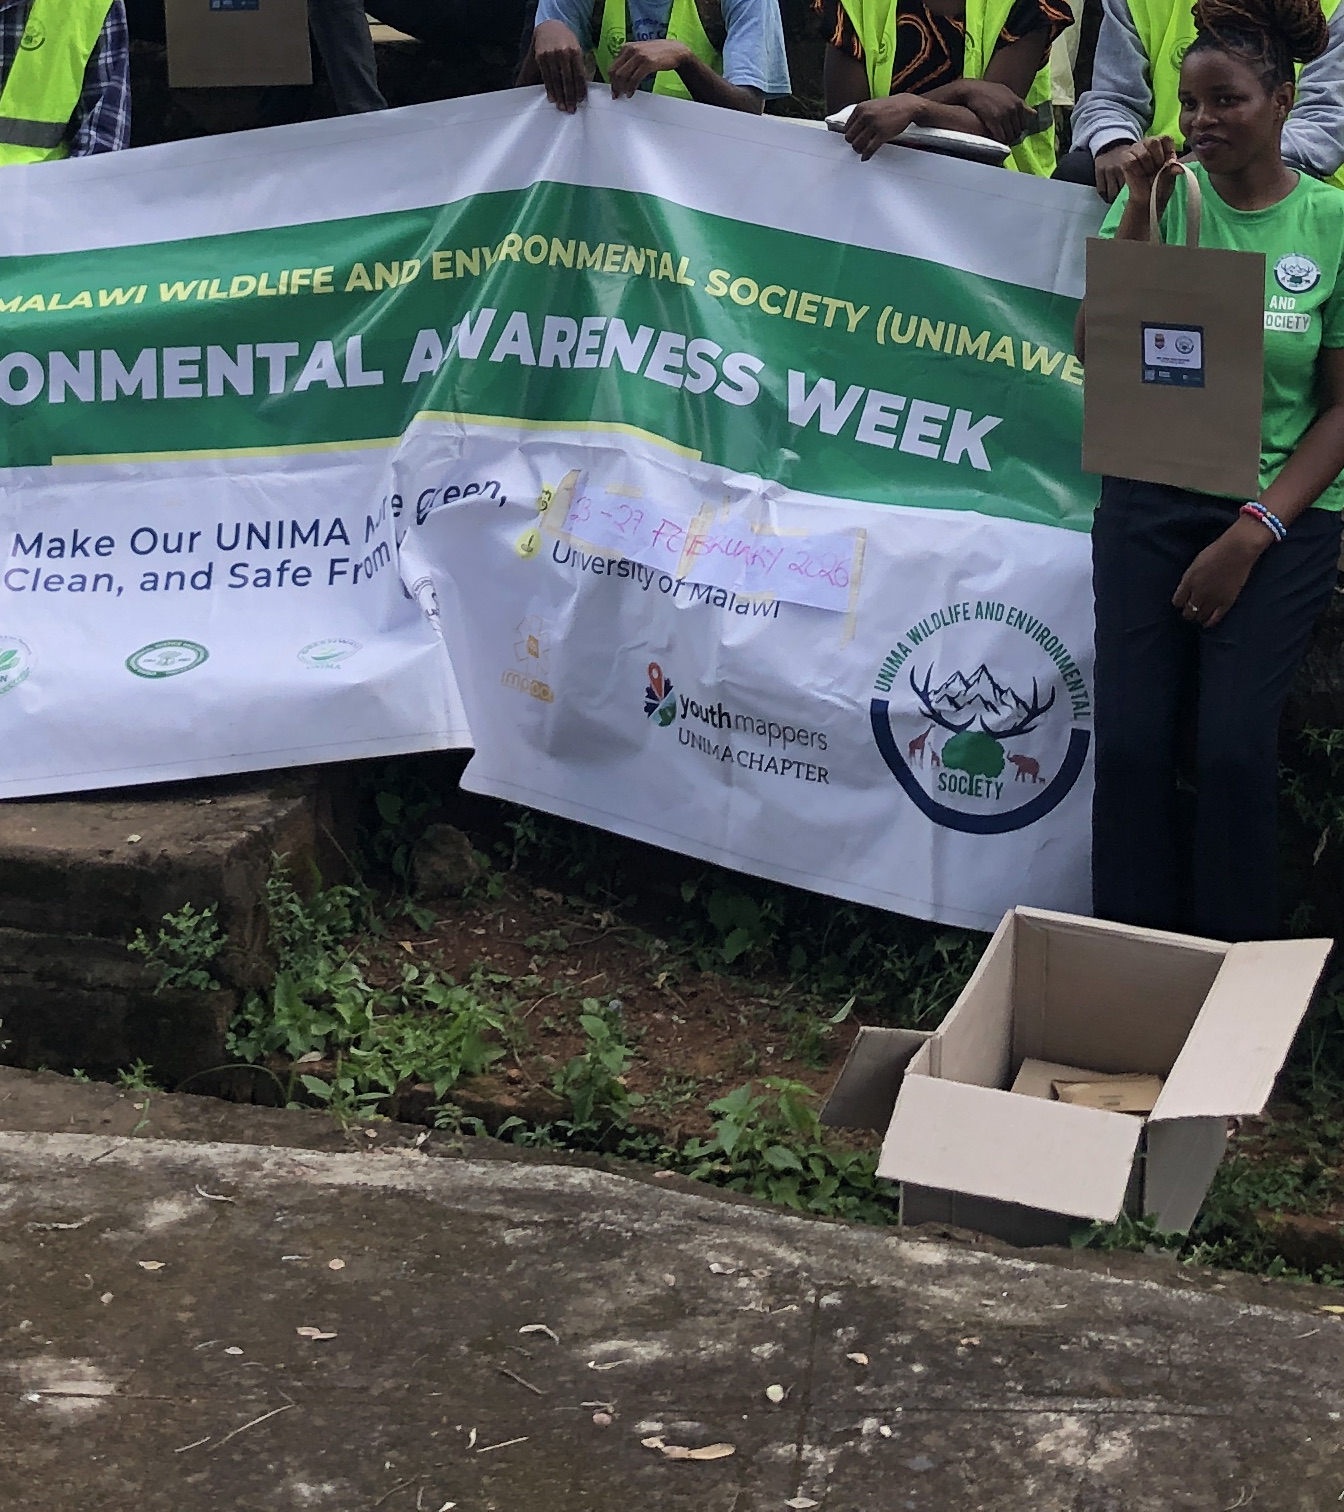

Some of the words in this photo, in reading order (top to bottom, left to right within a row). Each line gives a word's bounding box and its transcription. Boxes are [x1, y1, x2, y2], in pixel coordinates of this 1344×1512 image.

[157, 264, 336, 303] WILDLIFE
[345, 258, 421, 293] AND
[431, 231, 696, 288] ENVIRONMENTAL
[704, 267, 871, 334] SOCIETY
[1269, 295, 1296, 310] AND
[403, 308, 767, 408] AWARENESS
[785, 370, 1004, 474] WEEK
[8, 528, 117, 560] Make
[130, 525, 202, 558] Our
[215, 517, 351, 552] UNIMA
[2, 565, 125, 597] Clean,
[139, 562, 213, 591] and
[228, 560, 312, 590] Safe
[328, 540, 391, 586] From
[689, 583, 781, 619] Malawi
[874, 641, 912, 693] UNIMA
[906, 601, 971, 646] WILDLIFE
[974, 600, 1005, 622] AND
[1005, 606, 1091, 720] ENVIRONMENTAL
[678, 727, 734, 763] UNIMA
[737, 750, 830, 785] CHAPTER
[938, 772, 1004, 800] SOCIETY
